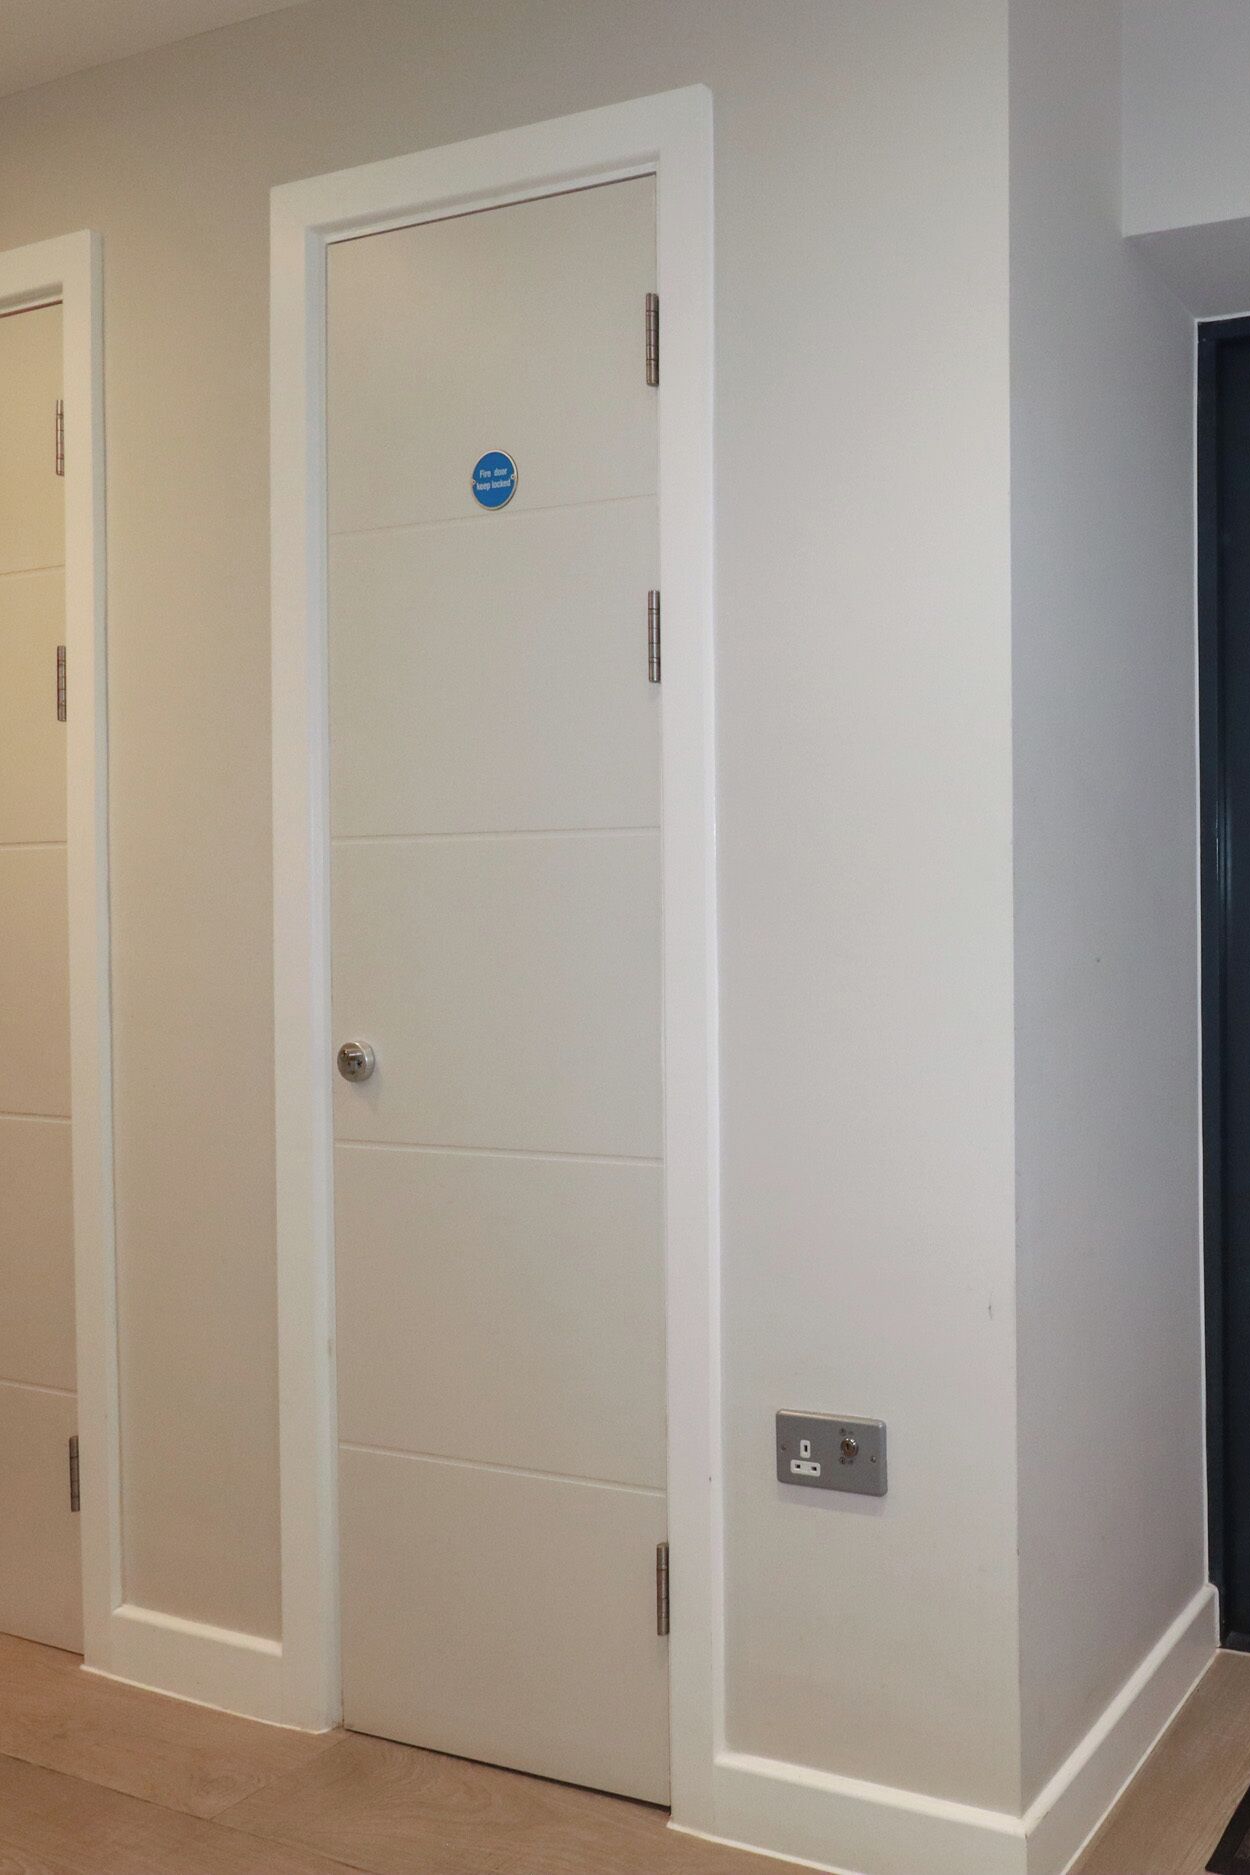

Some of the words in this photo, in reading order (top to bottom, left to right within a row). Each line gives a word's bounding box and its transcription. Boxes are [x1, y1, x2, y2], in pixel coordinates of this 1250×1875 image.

[479, 469, 492, 479] Fire
[494, 467, 508, 477] door
[476, 482, 490, 492] keep
[491, 479, 511, 489] locked
